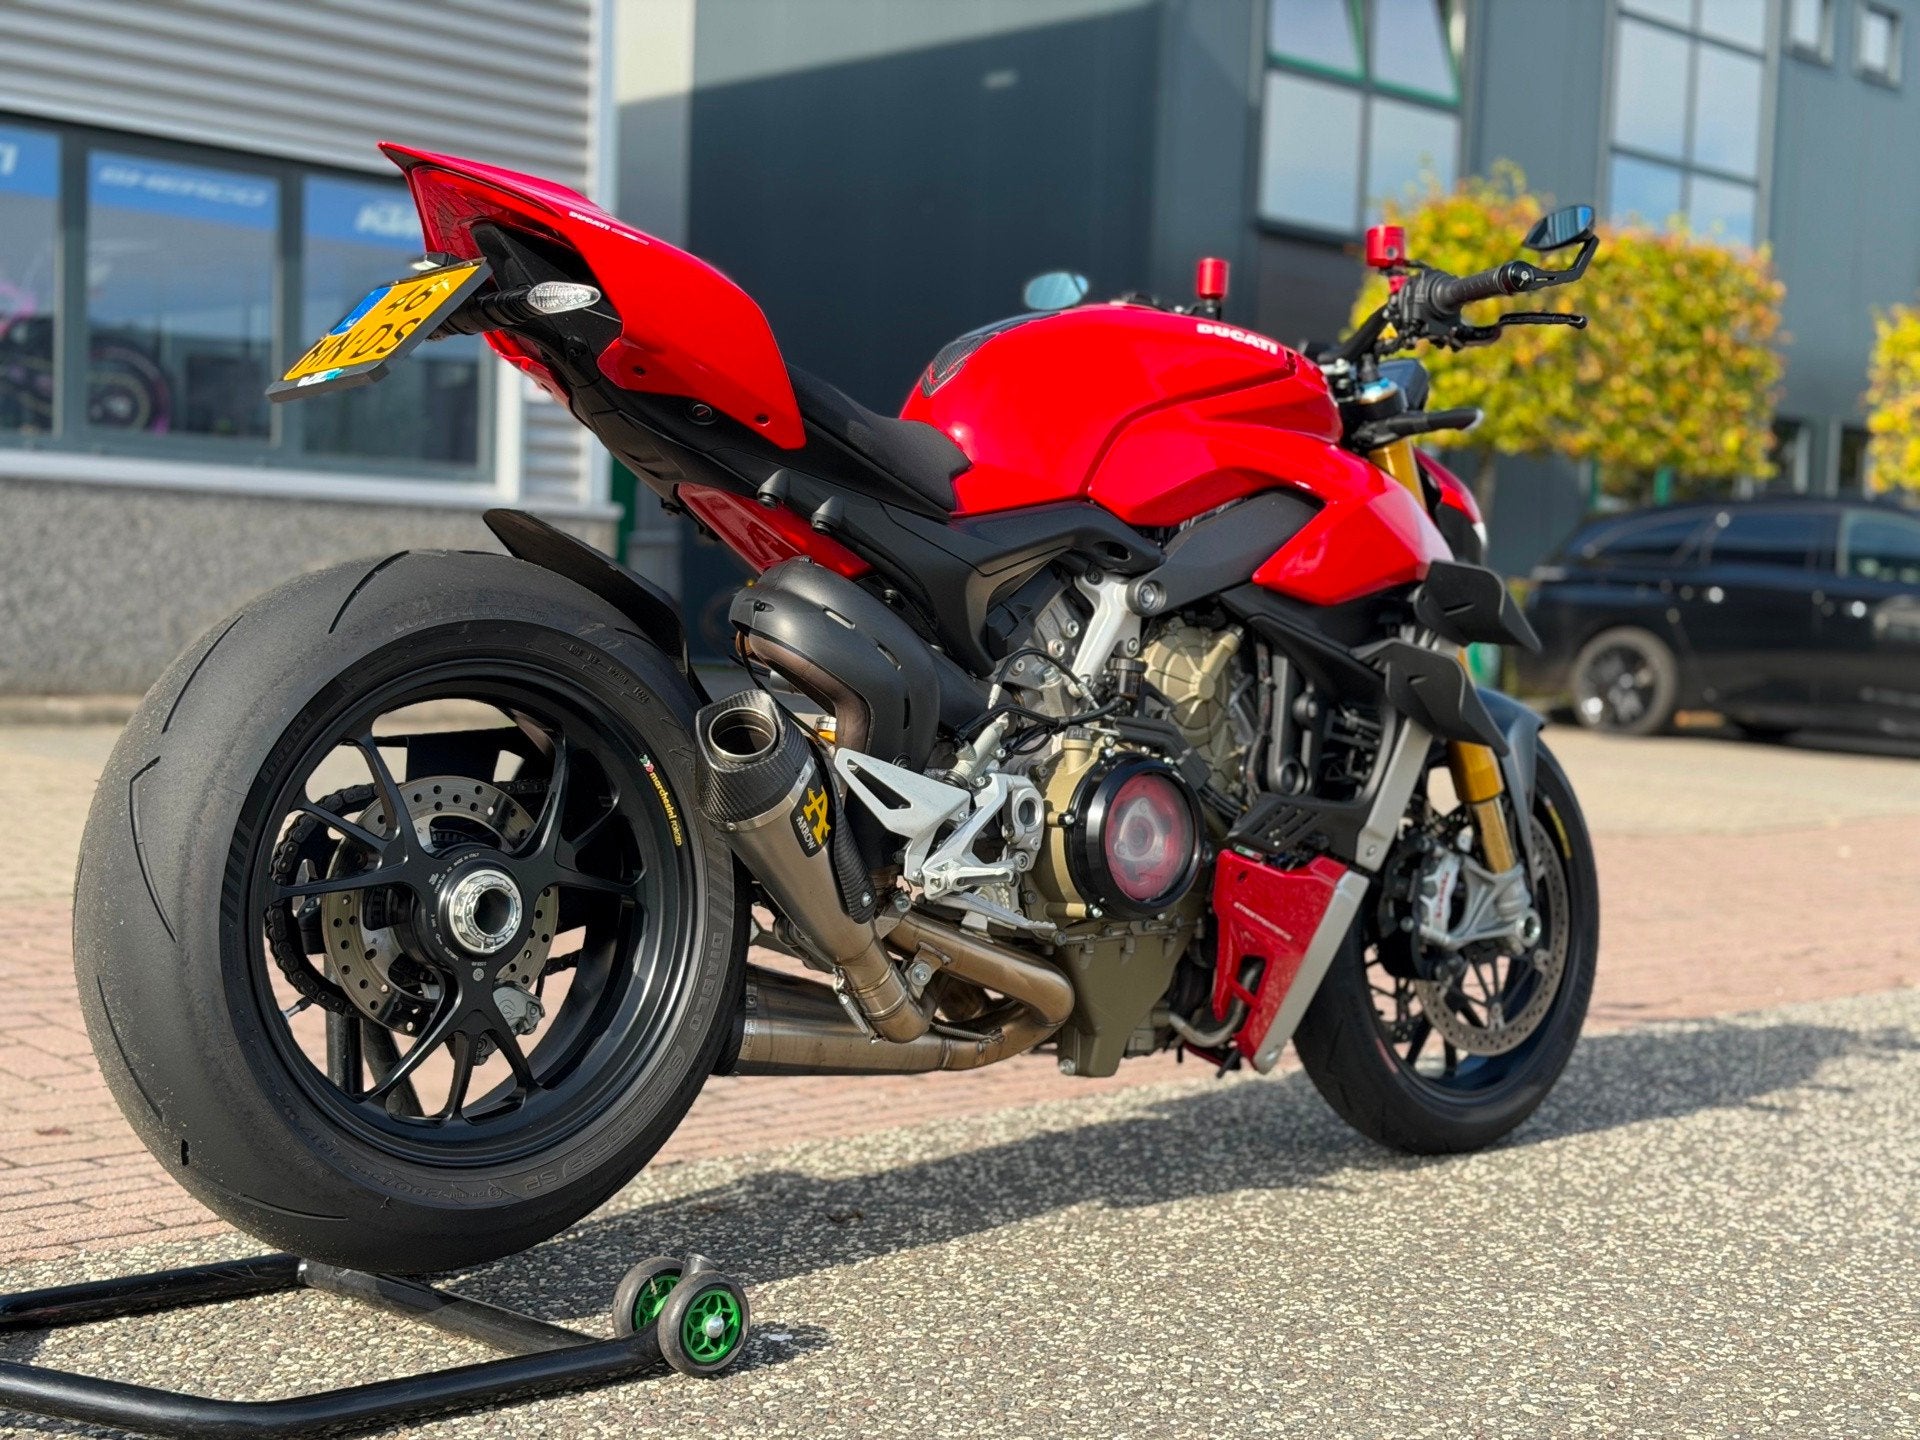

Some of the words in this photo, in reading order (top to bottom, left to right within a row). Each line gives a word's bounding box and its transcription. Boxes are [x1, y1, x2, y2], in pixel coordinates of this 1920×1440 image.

[568, 210, 610, 231] DUCATI
[385, 283, 437, 316] 46
[1196, 322, 1278, 355] DUCATI
[649, 772, 677, 820] marchesini
[796, 815, 817, 850] ARROW
[690, 931, 725, 1032] DIABLO
